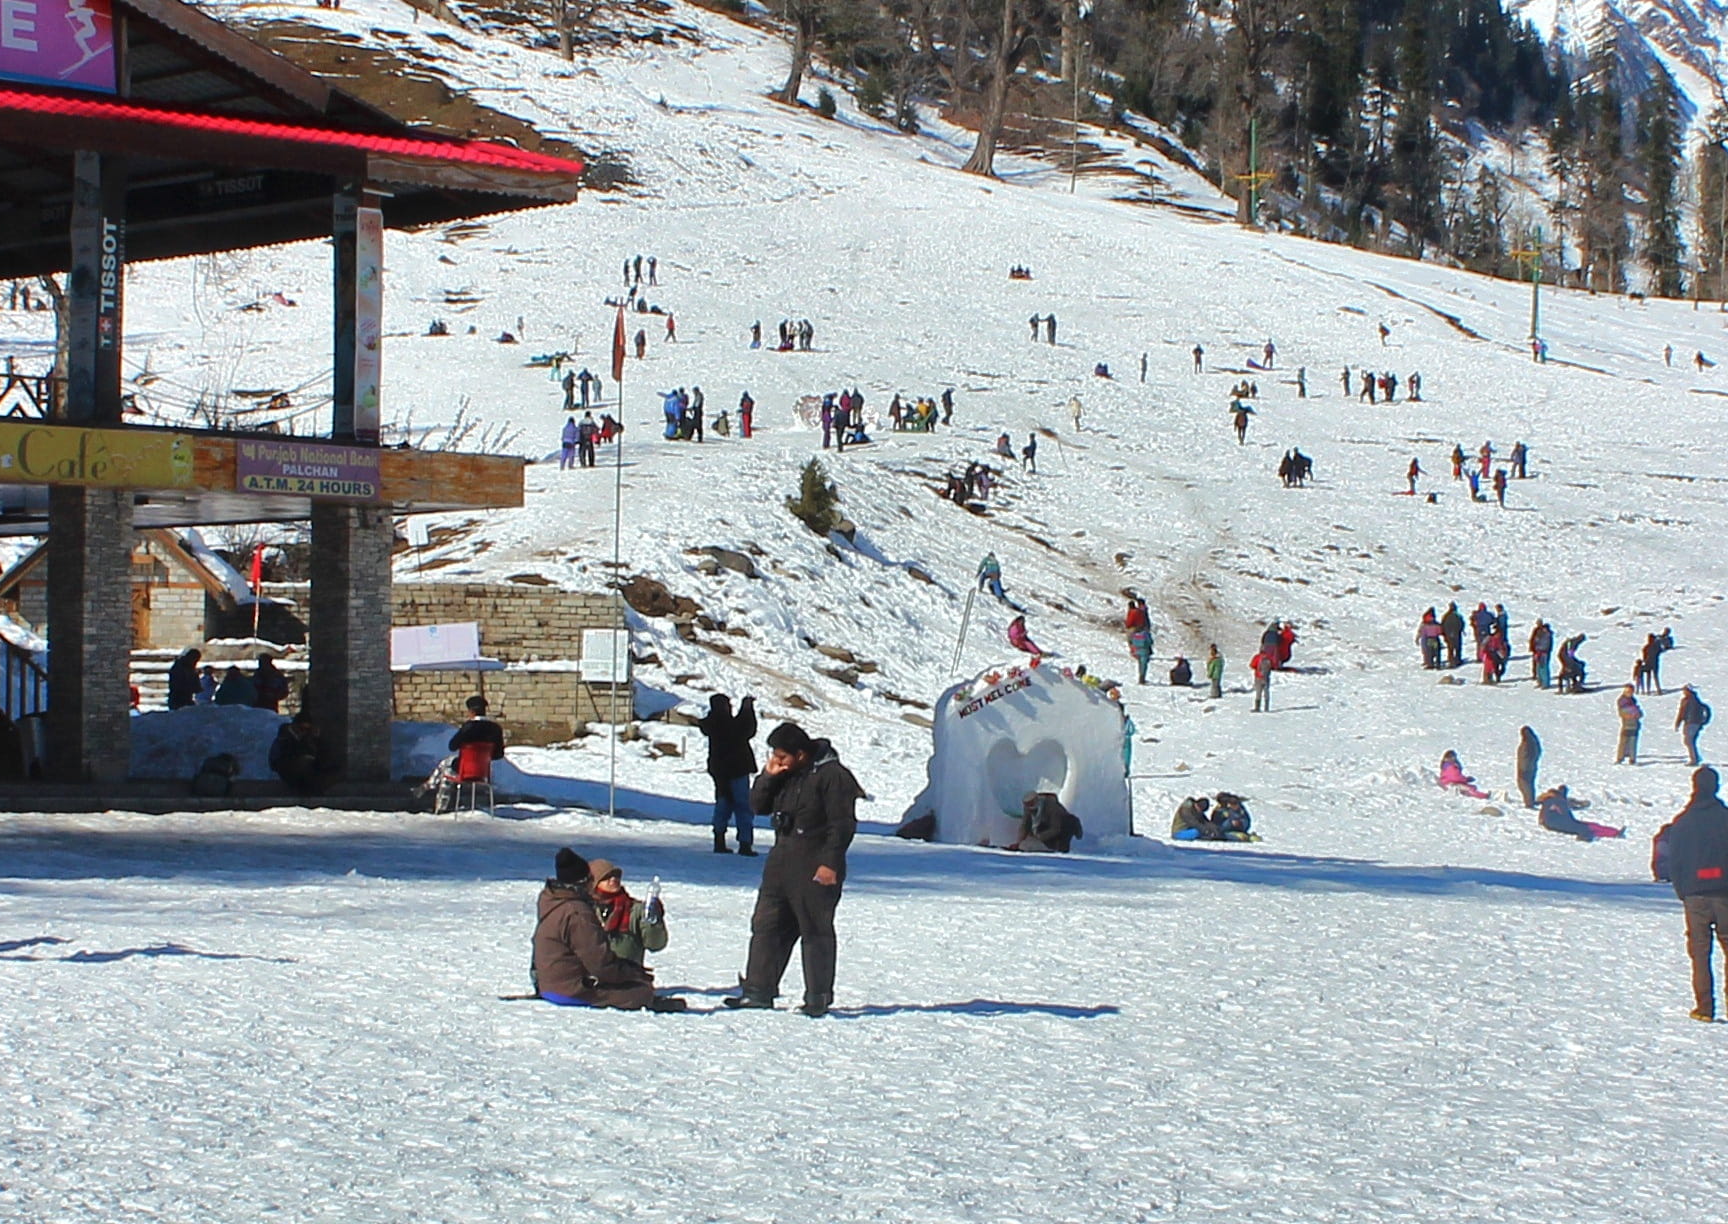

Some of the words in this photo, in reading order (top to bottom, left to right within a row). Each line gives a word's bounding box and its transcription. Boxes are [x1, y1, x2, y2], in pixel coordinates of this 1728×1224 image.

[100, 216, 118, 314] TISSOT
[17, 428, 108, 481] Café
[258, 444, 297, 464] Punjab
[300, 447, 347, 465] National
[282, 463, 339, 478] PALCHAN
[248, 476, 293, 491] A.T.M.
[297, 479, 315, 492] 24
[319, 481, 371, 496] HOURS
